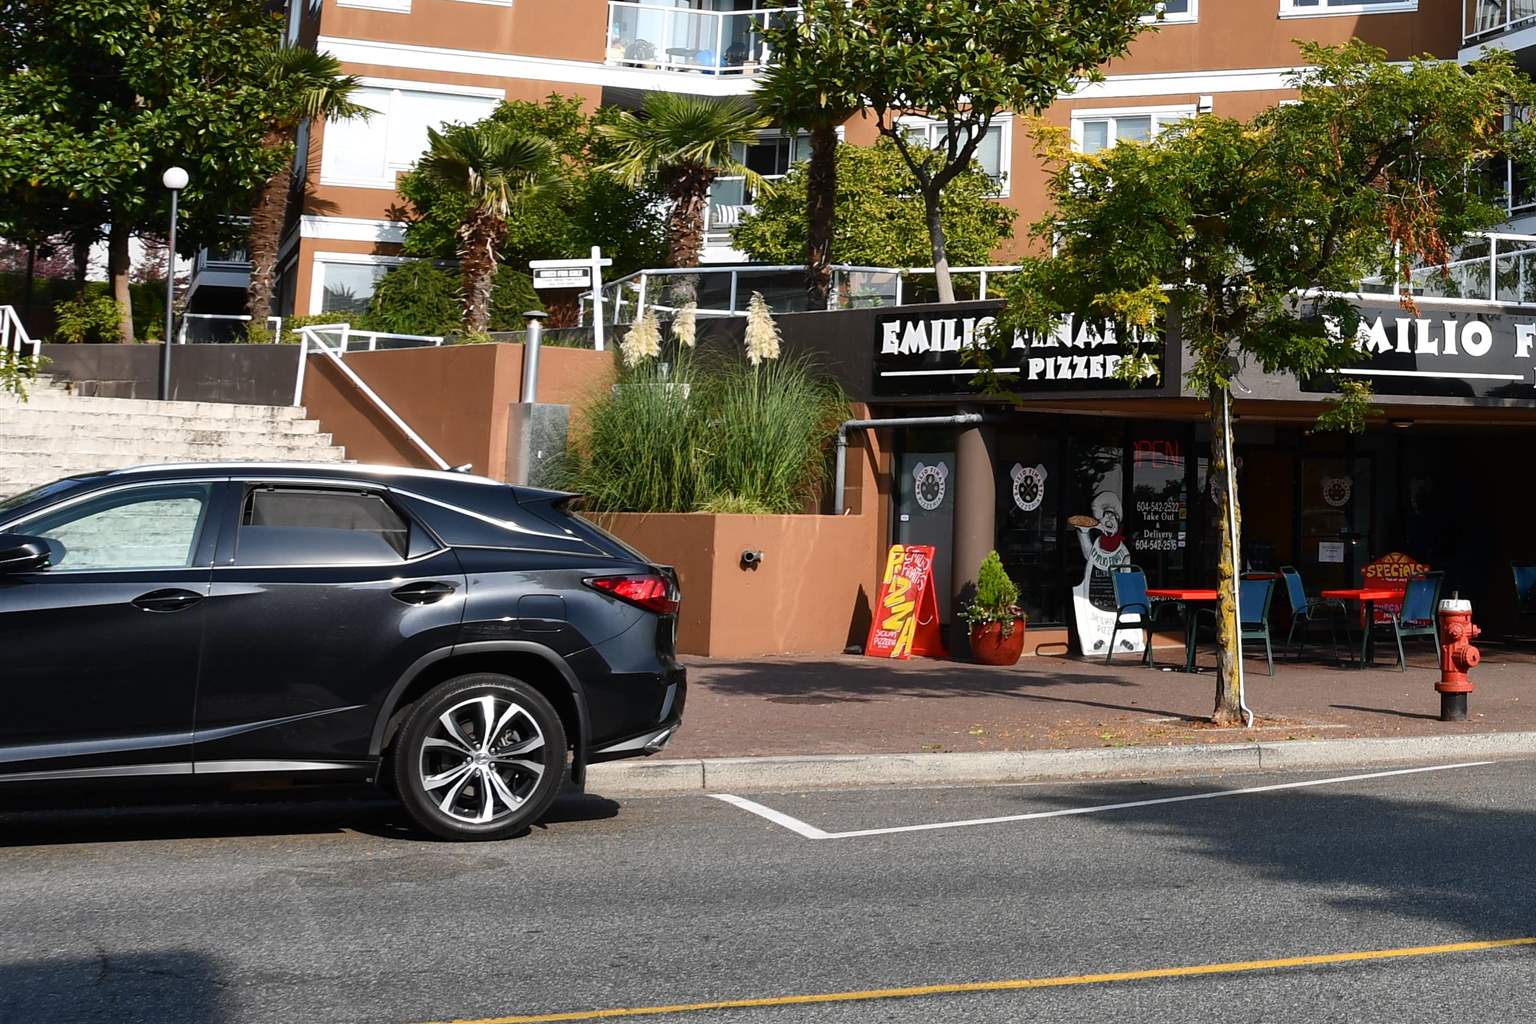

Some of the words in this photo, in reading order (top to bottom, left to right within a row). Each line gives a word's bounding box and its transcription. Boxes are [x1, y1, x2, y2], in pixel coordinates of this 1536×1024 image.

[1143, 511, 1159, 521] Take
[1161, 511, 1174, 521] Out
[1144, 529, 1173, 540] Delivery
